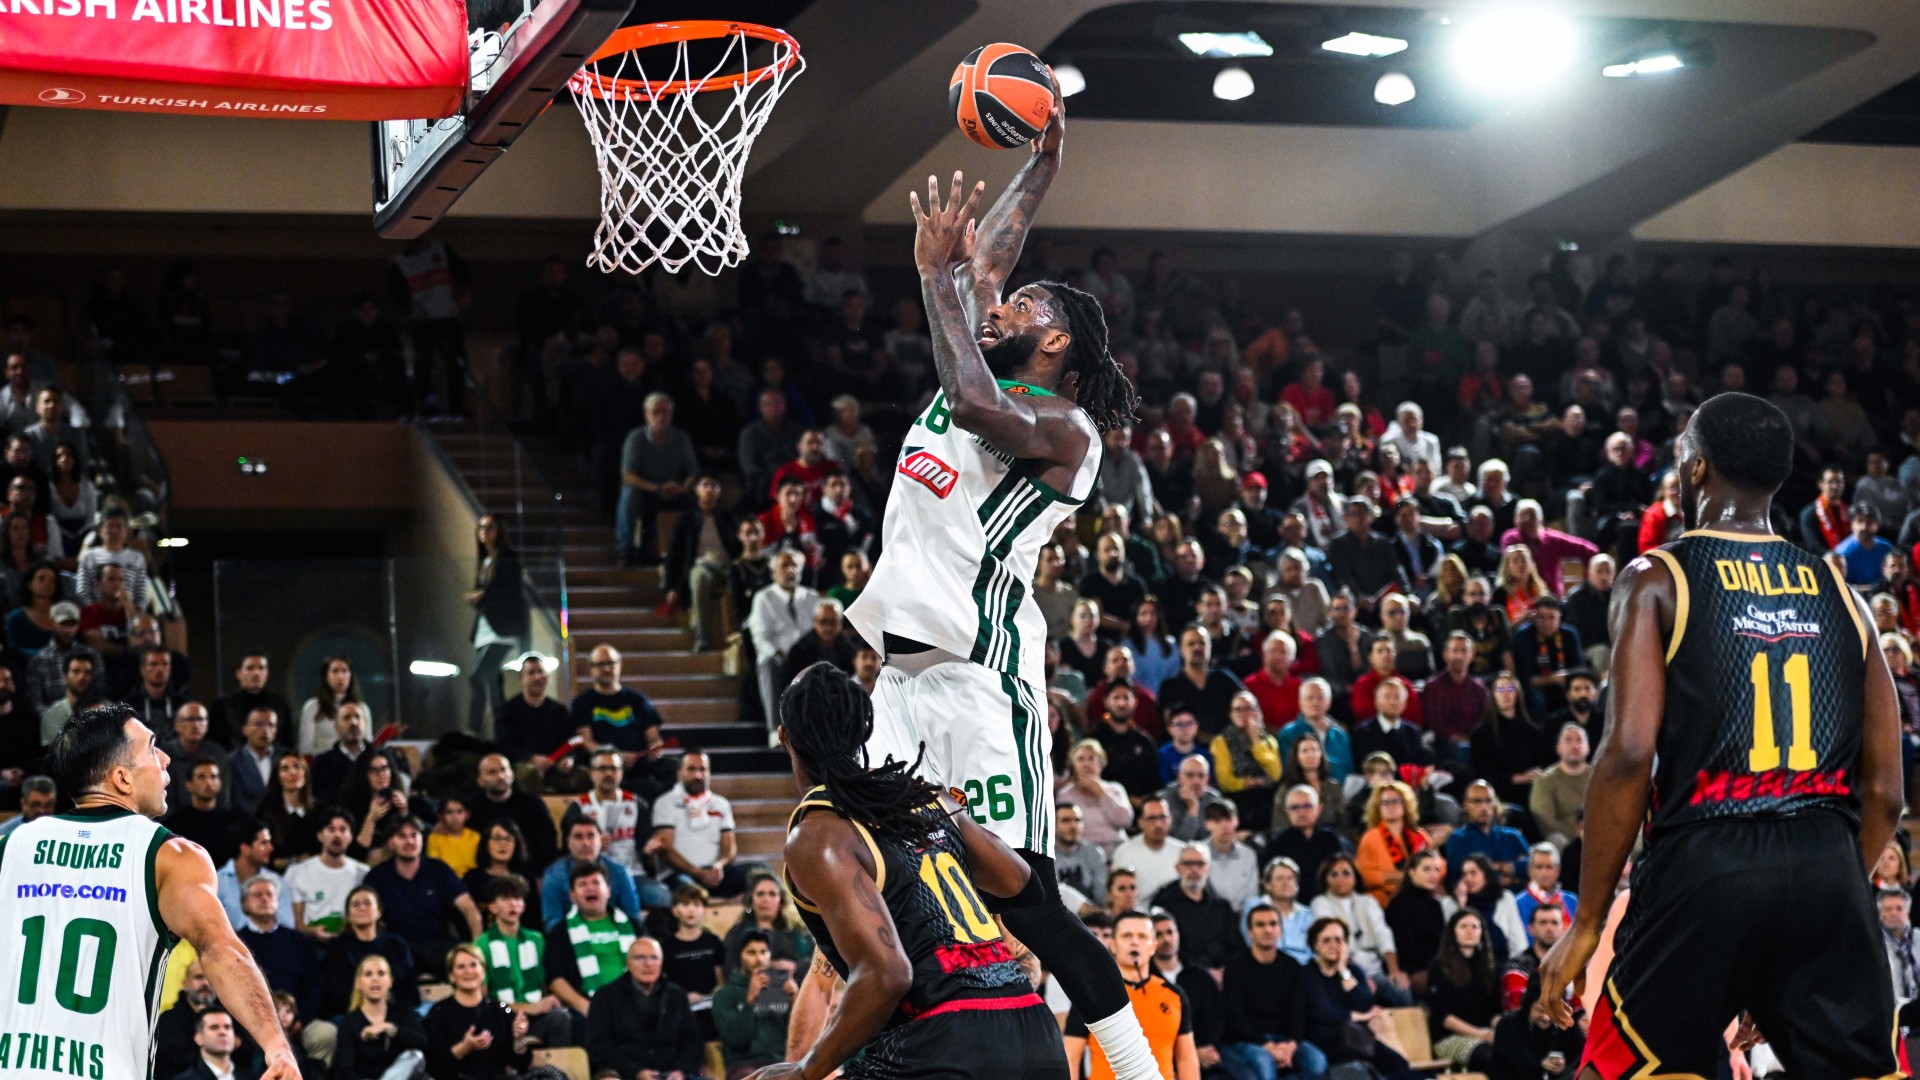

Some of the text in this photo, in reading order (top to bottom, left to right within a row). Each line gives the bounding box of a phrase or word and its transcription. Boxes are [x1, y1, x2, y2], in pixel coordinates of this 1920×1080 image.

[132, 0, 333, 30] AIRLINES
[98, 95, 327, 113] TURKISH AIRLINES
[914, 393, 951, 435] 6
[1715, 560, 1820, 596] DIALLO
[1747, 604, 1797, 622] GROUPE
[1776, 620, 1820, 634] PASTOR
[1749, 652, 1817, 772] 11
[964, 774, 1016, 824] 26
[33, 840, 125, 870] SLOUKAS
[17, 882, 127, 903] more.com
[918, 852, 1003, 944] 10
[17, 914, 118, 1015] 10
[0, 1032, 104, 1080] ATHENS
